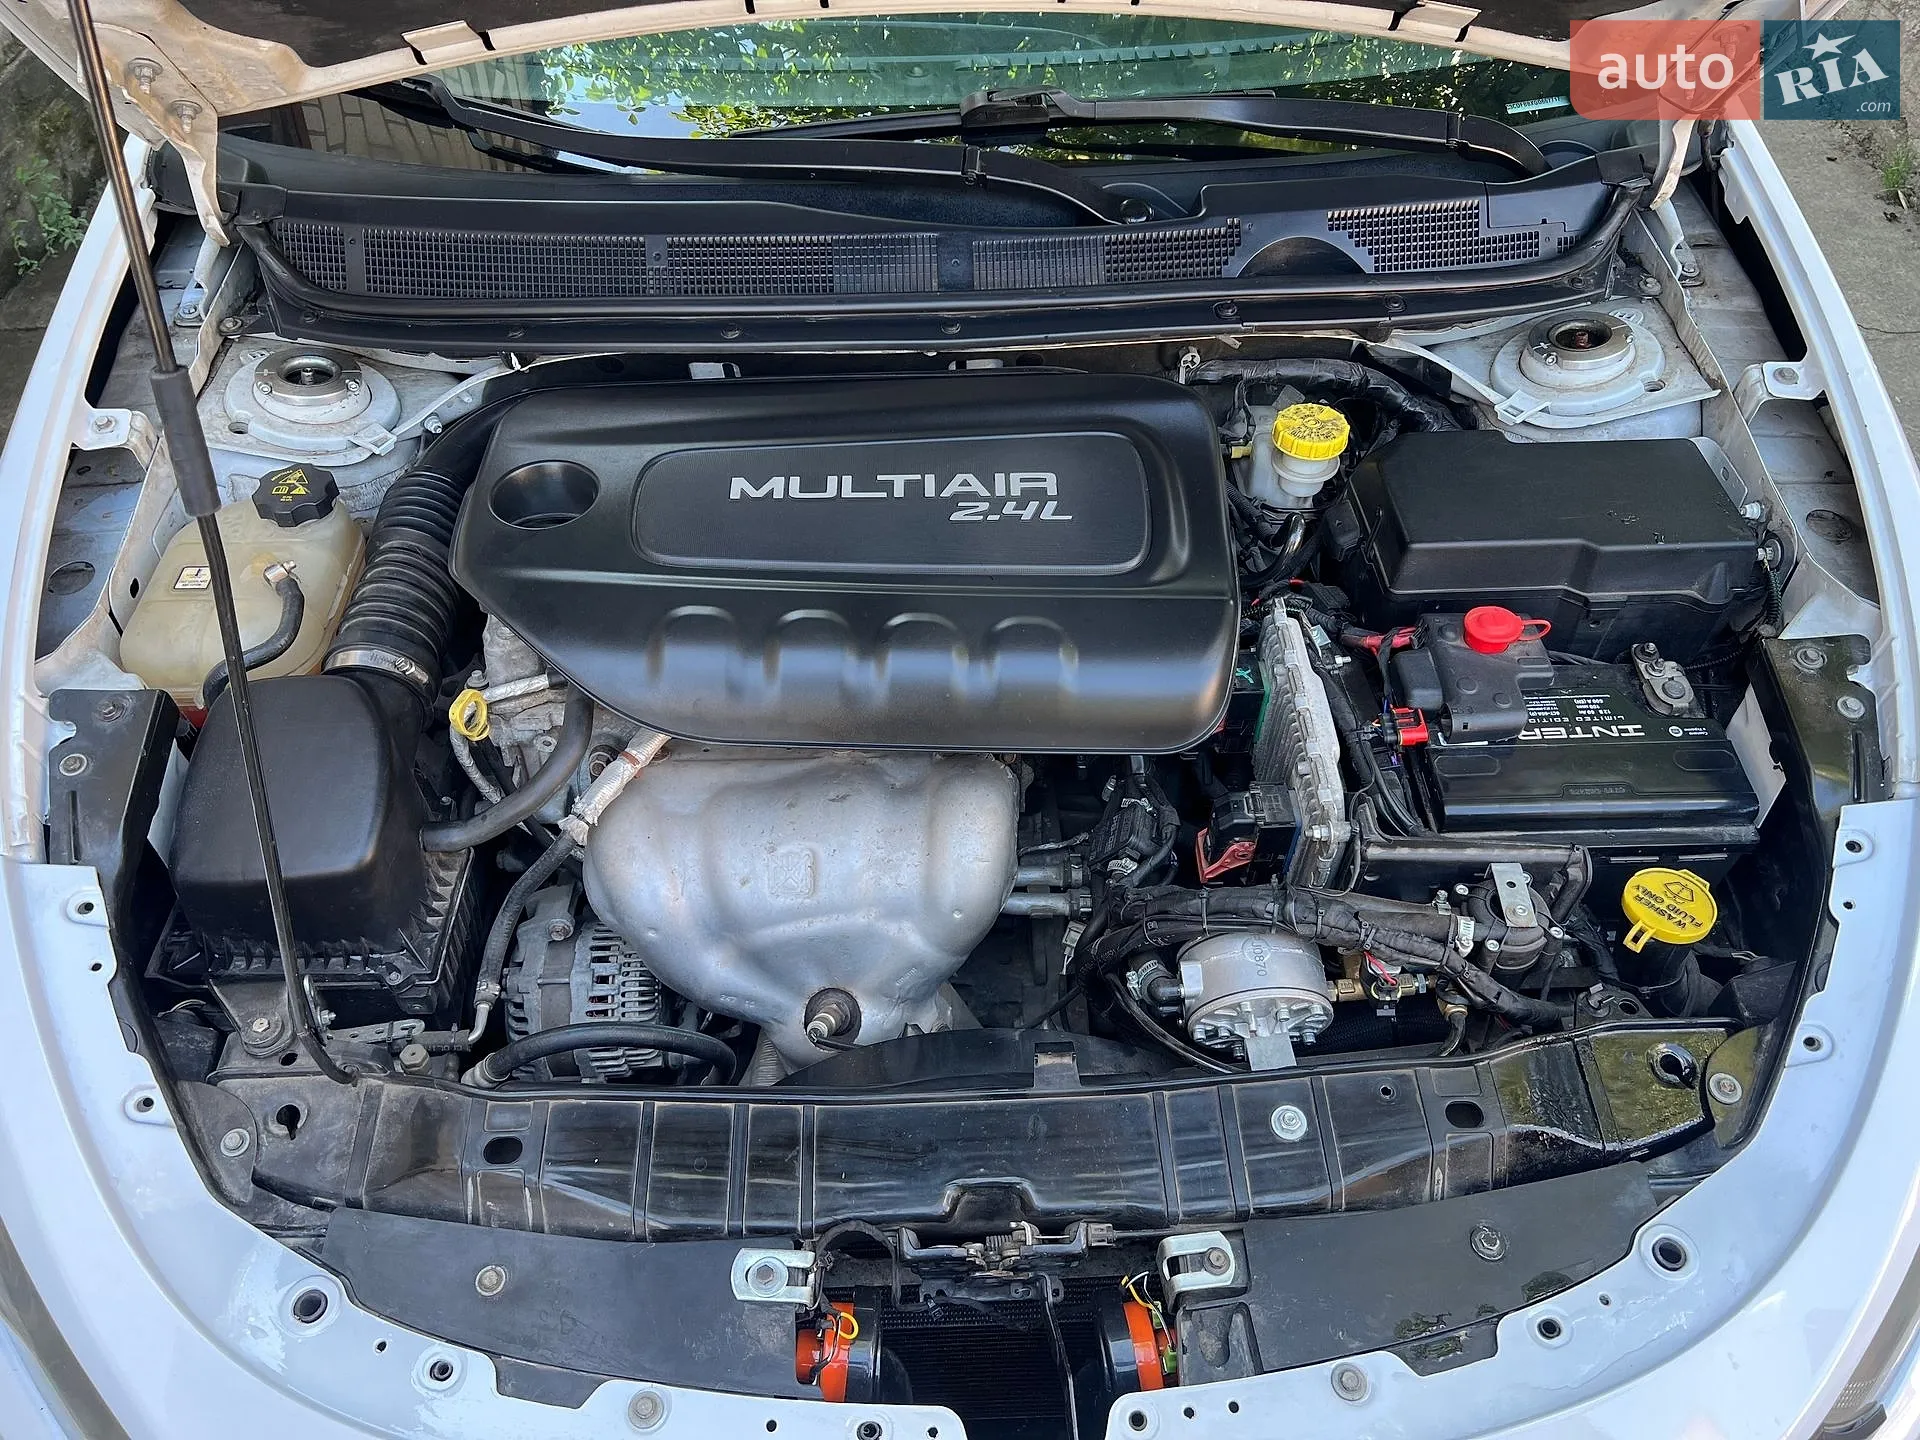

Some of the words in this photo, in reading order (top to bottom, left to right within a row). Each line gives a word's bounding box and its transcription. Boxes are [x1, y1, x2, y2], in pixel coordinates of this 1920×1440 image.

[728, 472, 1058, 500] MULTIAIR
[948, 500, 1073, 521] 2.4L
[1527, 716, 1570, 724] EDITIO
[1517, 724, 1646, 741] INTER
[1633, 893, 1688, 930] WASHER
[1666, 903, 1704, 929] FLUID
